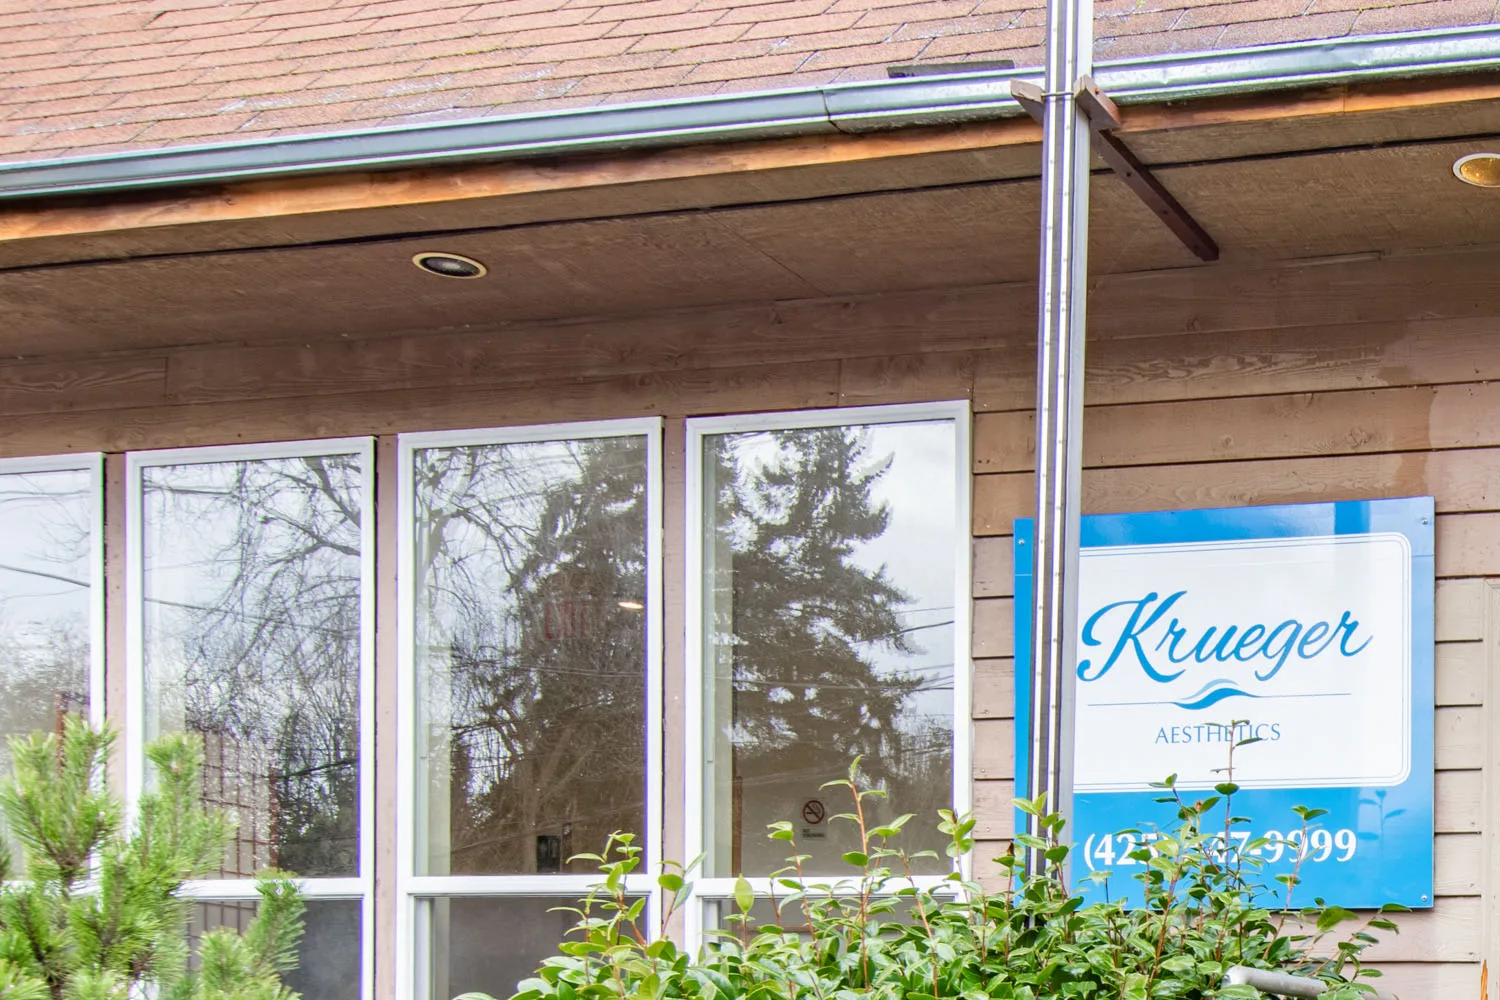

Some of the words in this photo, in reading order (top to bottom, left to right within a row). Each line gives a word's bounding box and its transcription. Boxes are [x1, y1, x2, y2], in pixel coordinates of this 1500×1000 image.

[1076, 590, 1373, 683] Krueger
[1155, 723, 1281, 744] AESTHETICS
[1084, 831, 1173, 871] (425
[1184, 829, 1357, 863] 47-9999
